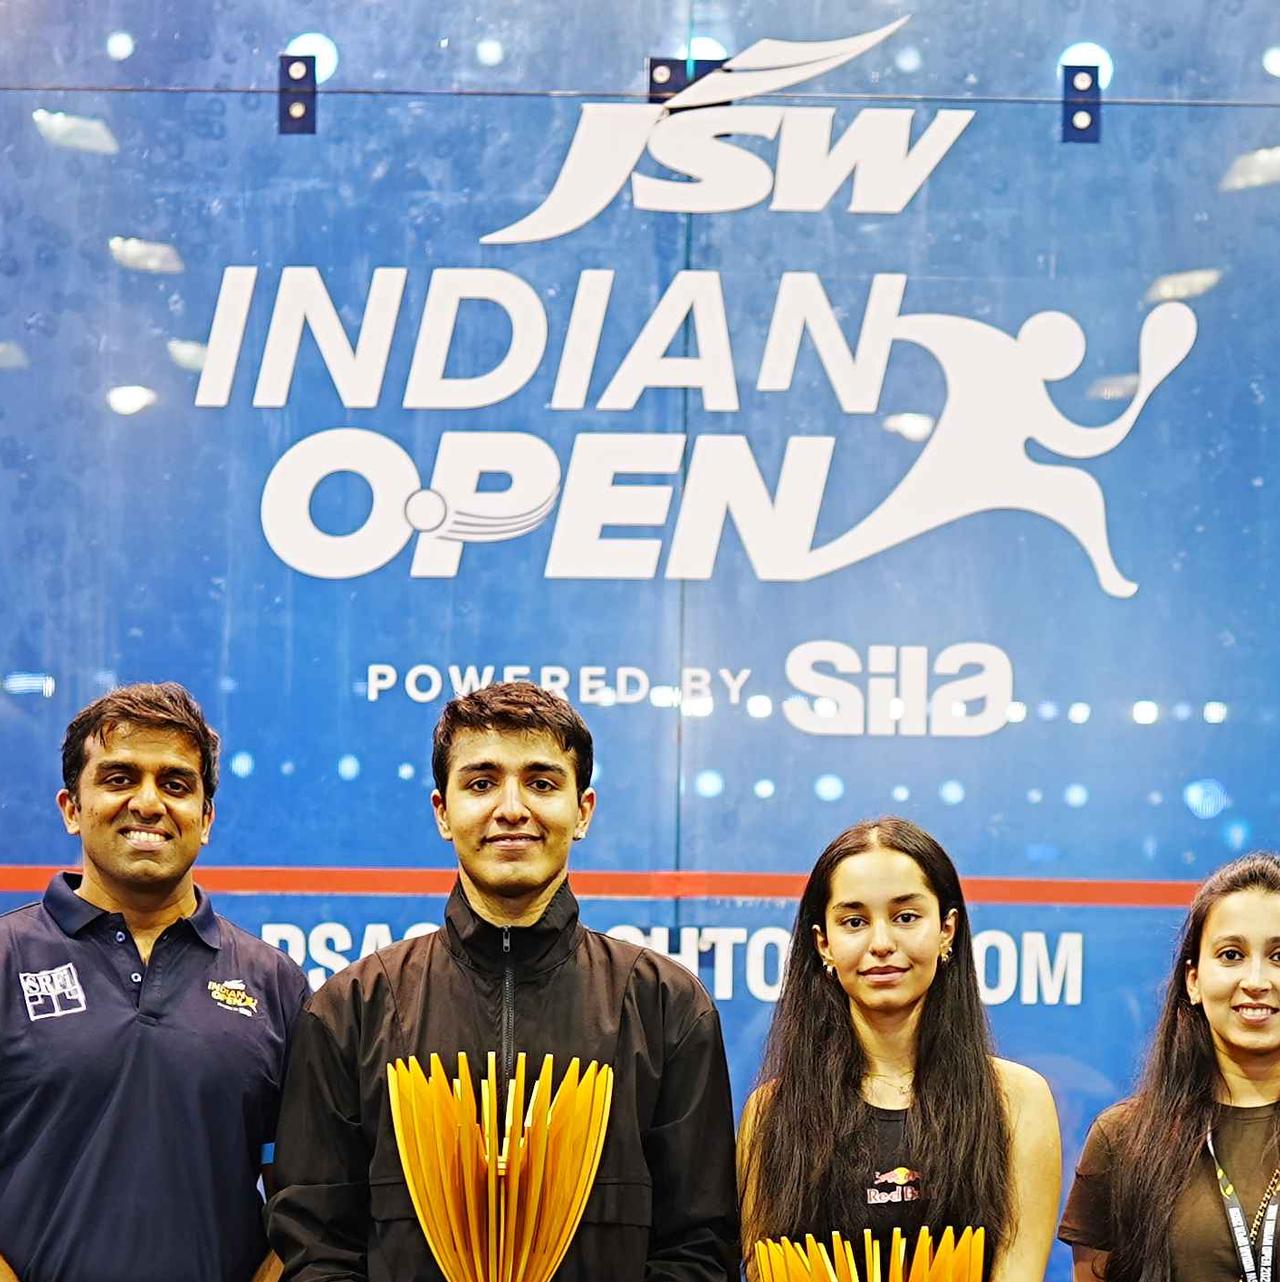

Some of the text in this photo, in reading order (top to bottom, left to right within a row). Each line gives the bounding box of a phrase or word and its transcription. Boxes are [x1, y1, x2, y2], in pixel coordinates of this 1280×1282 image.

[479, 102, 977, 245] JSW
[194, 265, 907, 413] INDIAN
[260, 427, 836, 581] OPEN
[683, 667, 752, 703] BY
[784, 640, 1014, 737] Sila
[867, 1186, 902, 1204] Red
